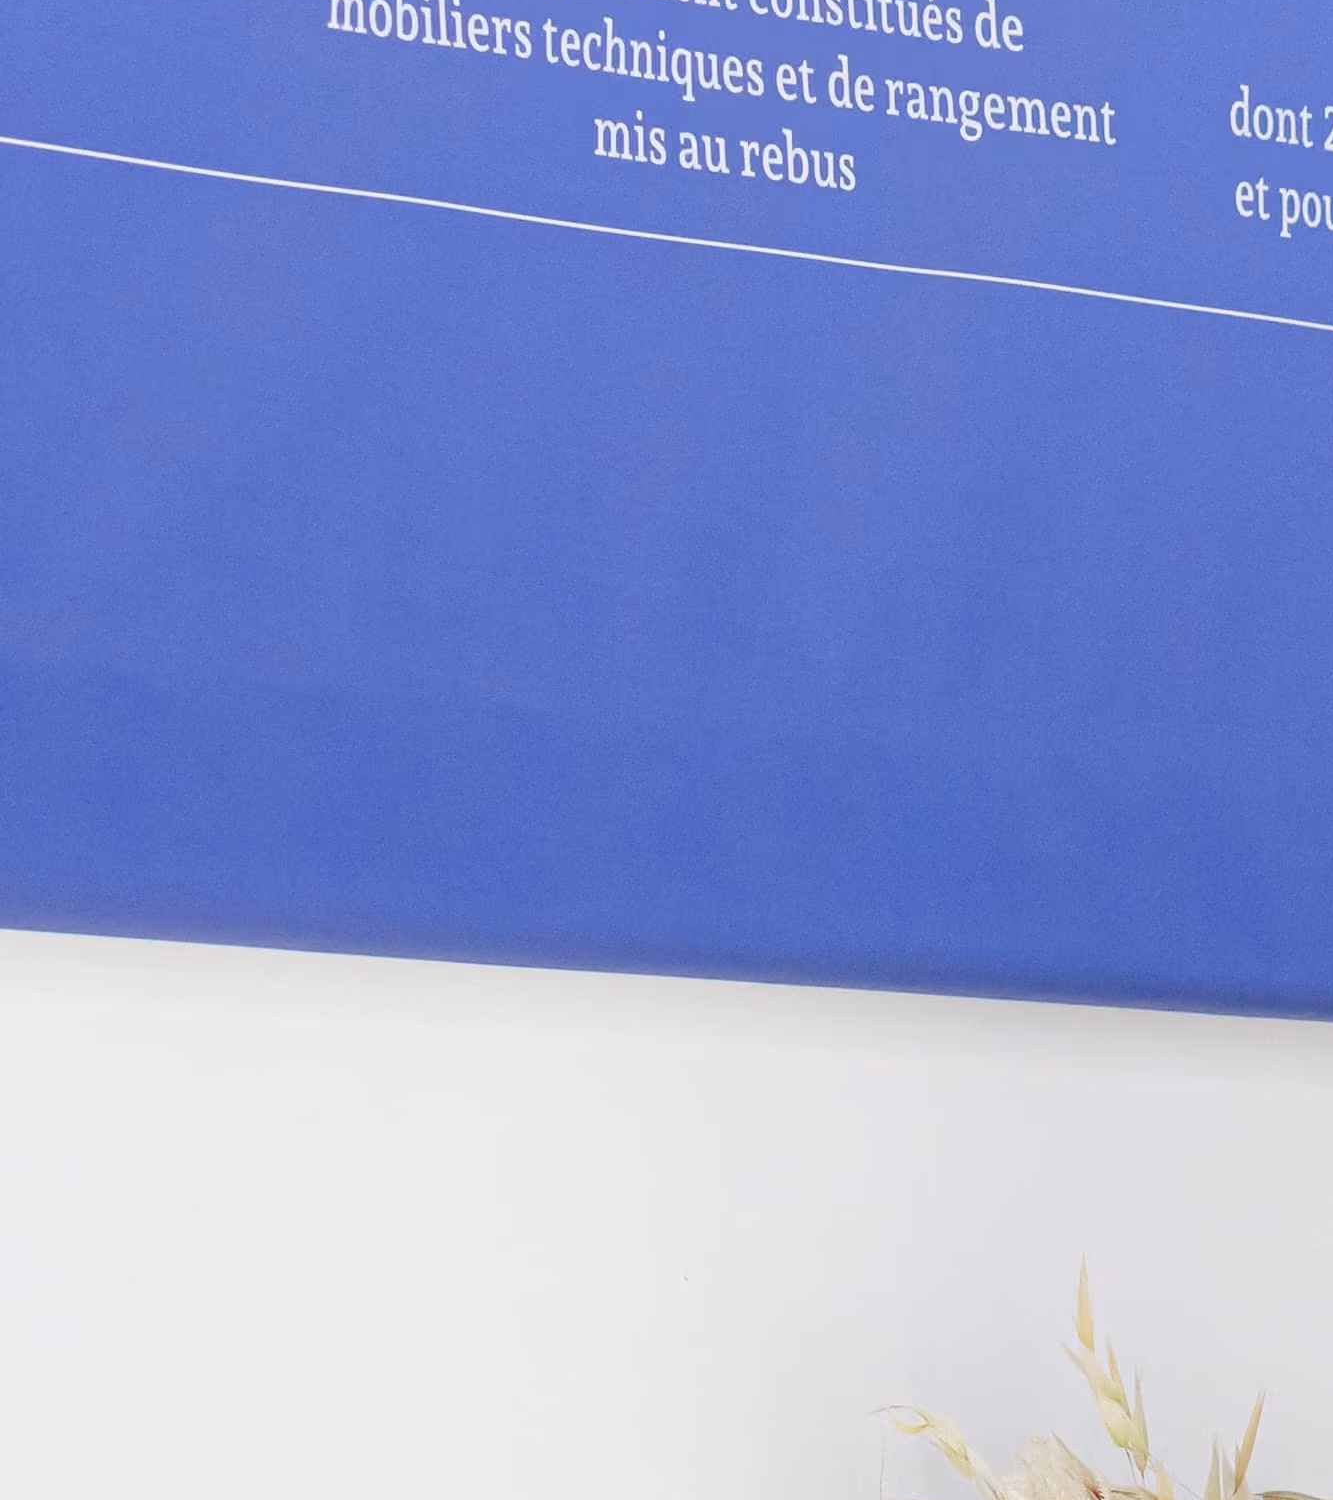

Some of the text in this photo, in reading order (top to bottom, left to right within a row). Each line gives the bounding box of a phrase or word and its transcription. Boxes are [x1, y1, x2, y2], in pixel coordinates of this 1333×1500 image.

[542, 16, 765, 102] techniques
[776, 59, 817, 104] et
[828, 53, 875, 112] de
[884, 79, 1117, 146] rangement
[1230, 84, 1314, 148] dont
[594, 109, 856, 191] mis au rebus
[1235, 177, 1271, 221] et
